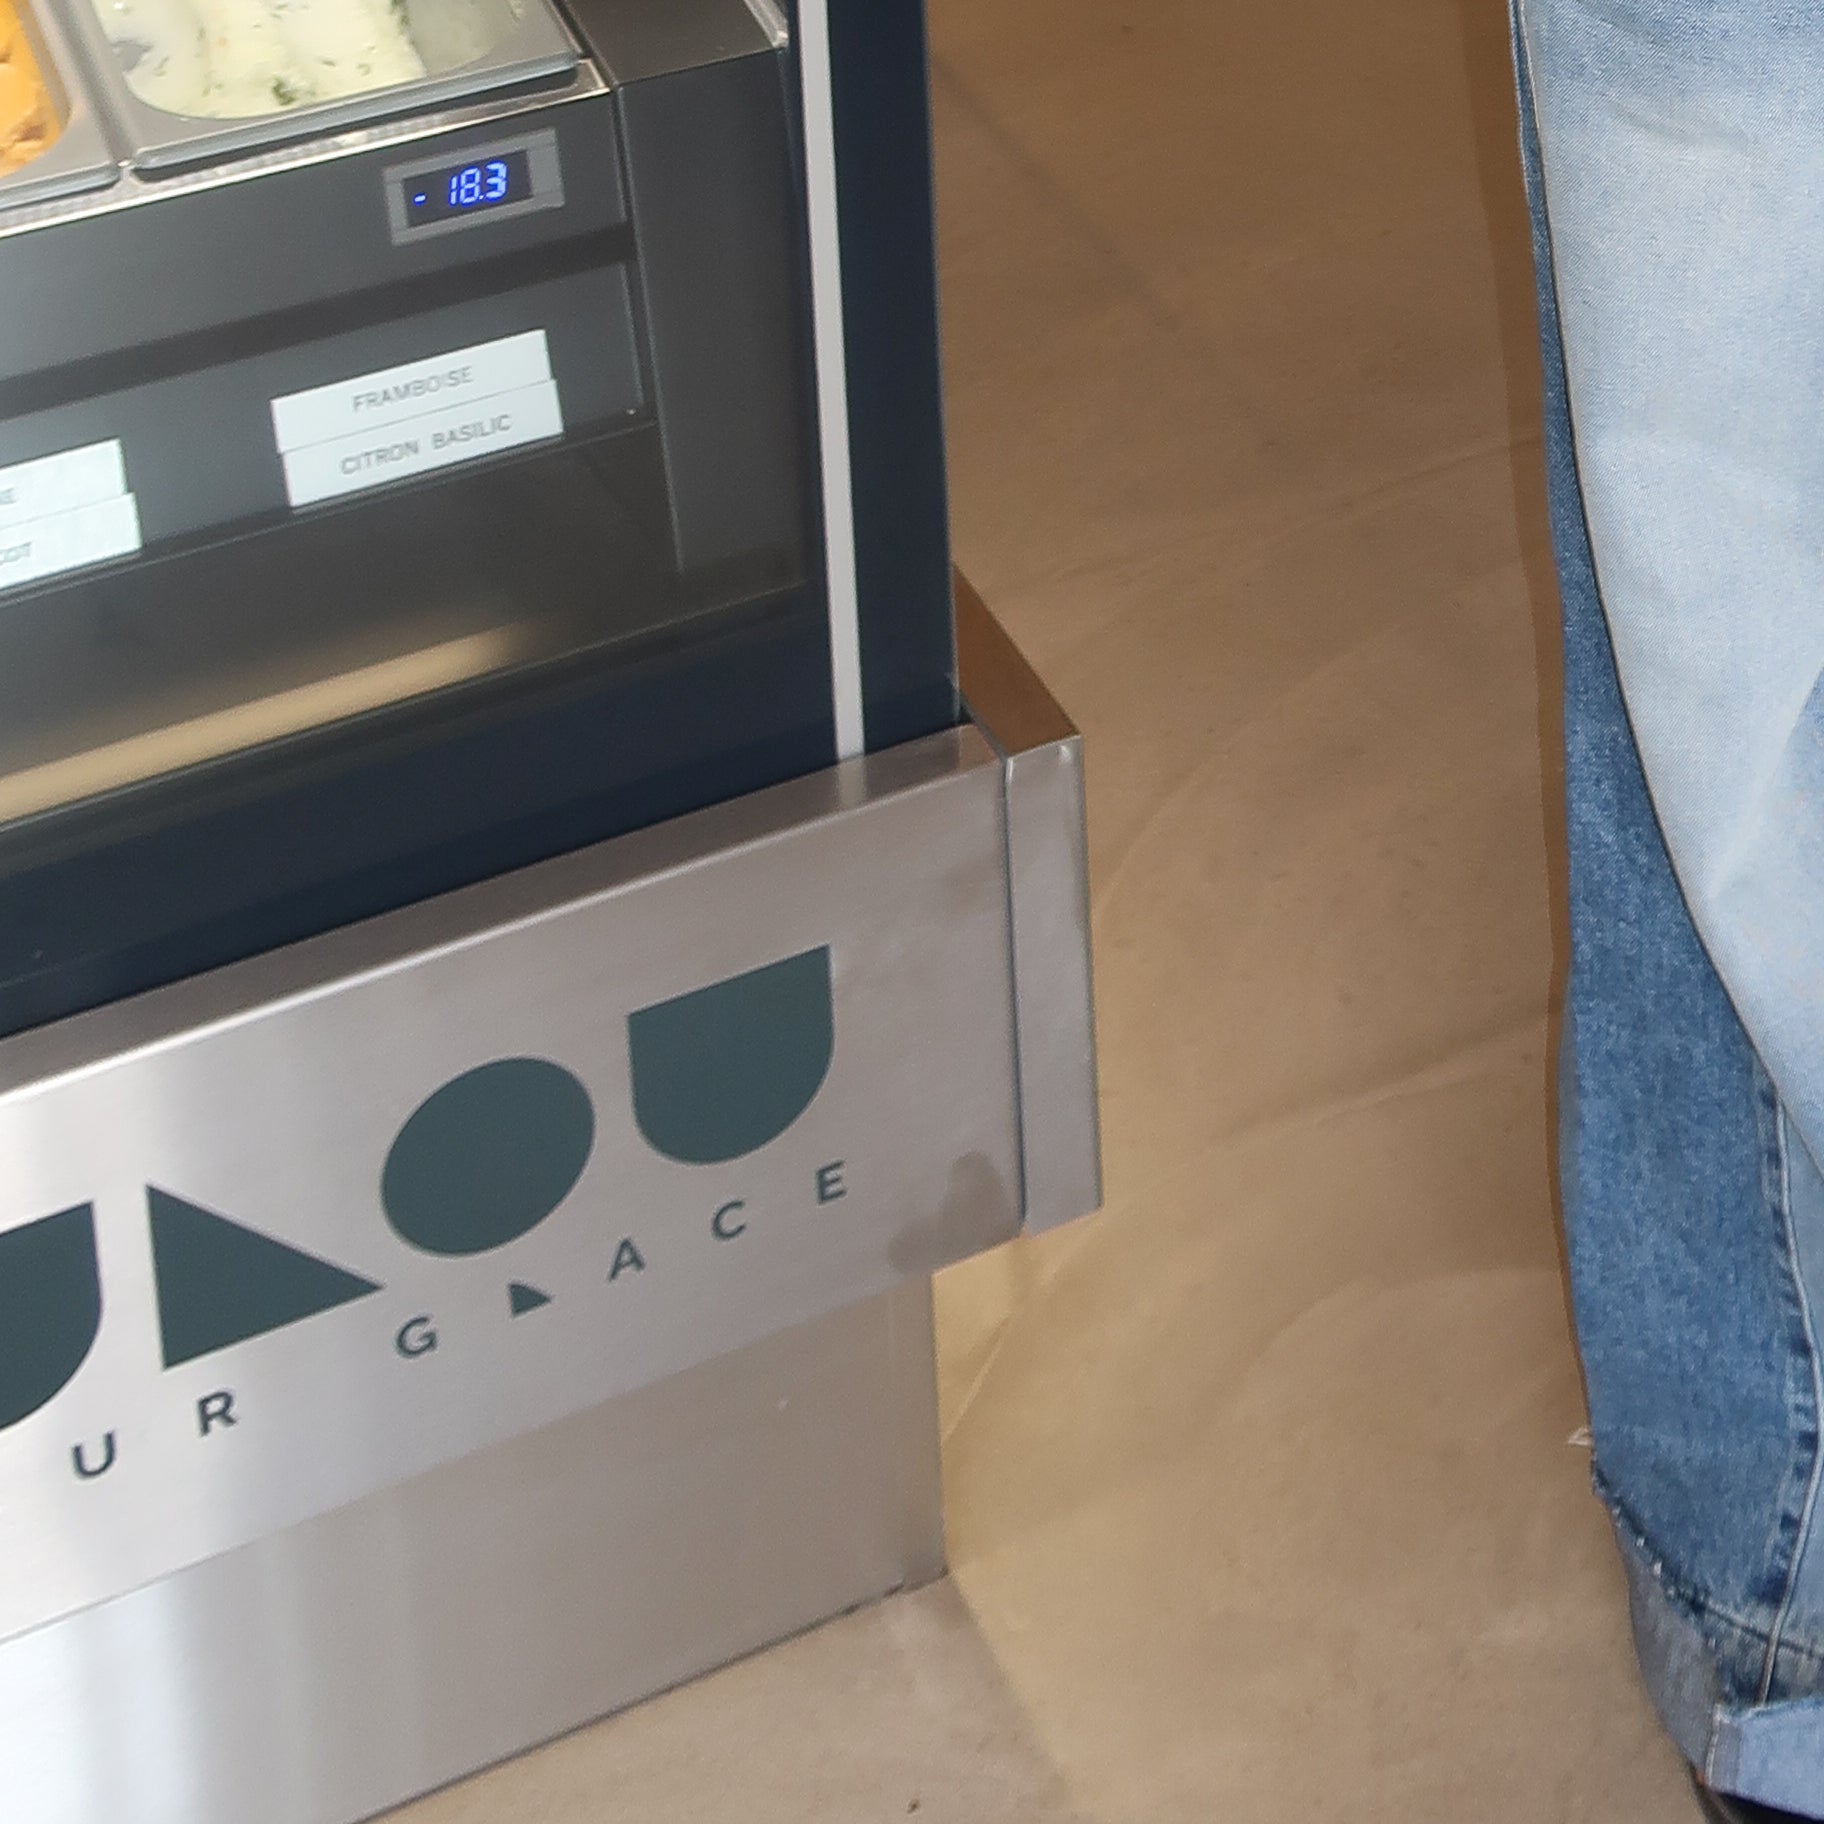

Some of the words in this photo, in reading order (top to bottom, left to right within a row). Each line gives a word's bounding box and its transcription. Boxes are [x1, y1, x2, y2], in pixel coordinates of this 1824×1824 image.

[353, 365, 474, 411] FRAMBOISE
[339, 438, 420, 476] CITRON
[432, 413, 513, 450] BASILIC
